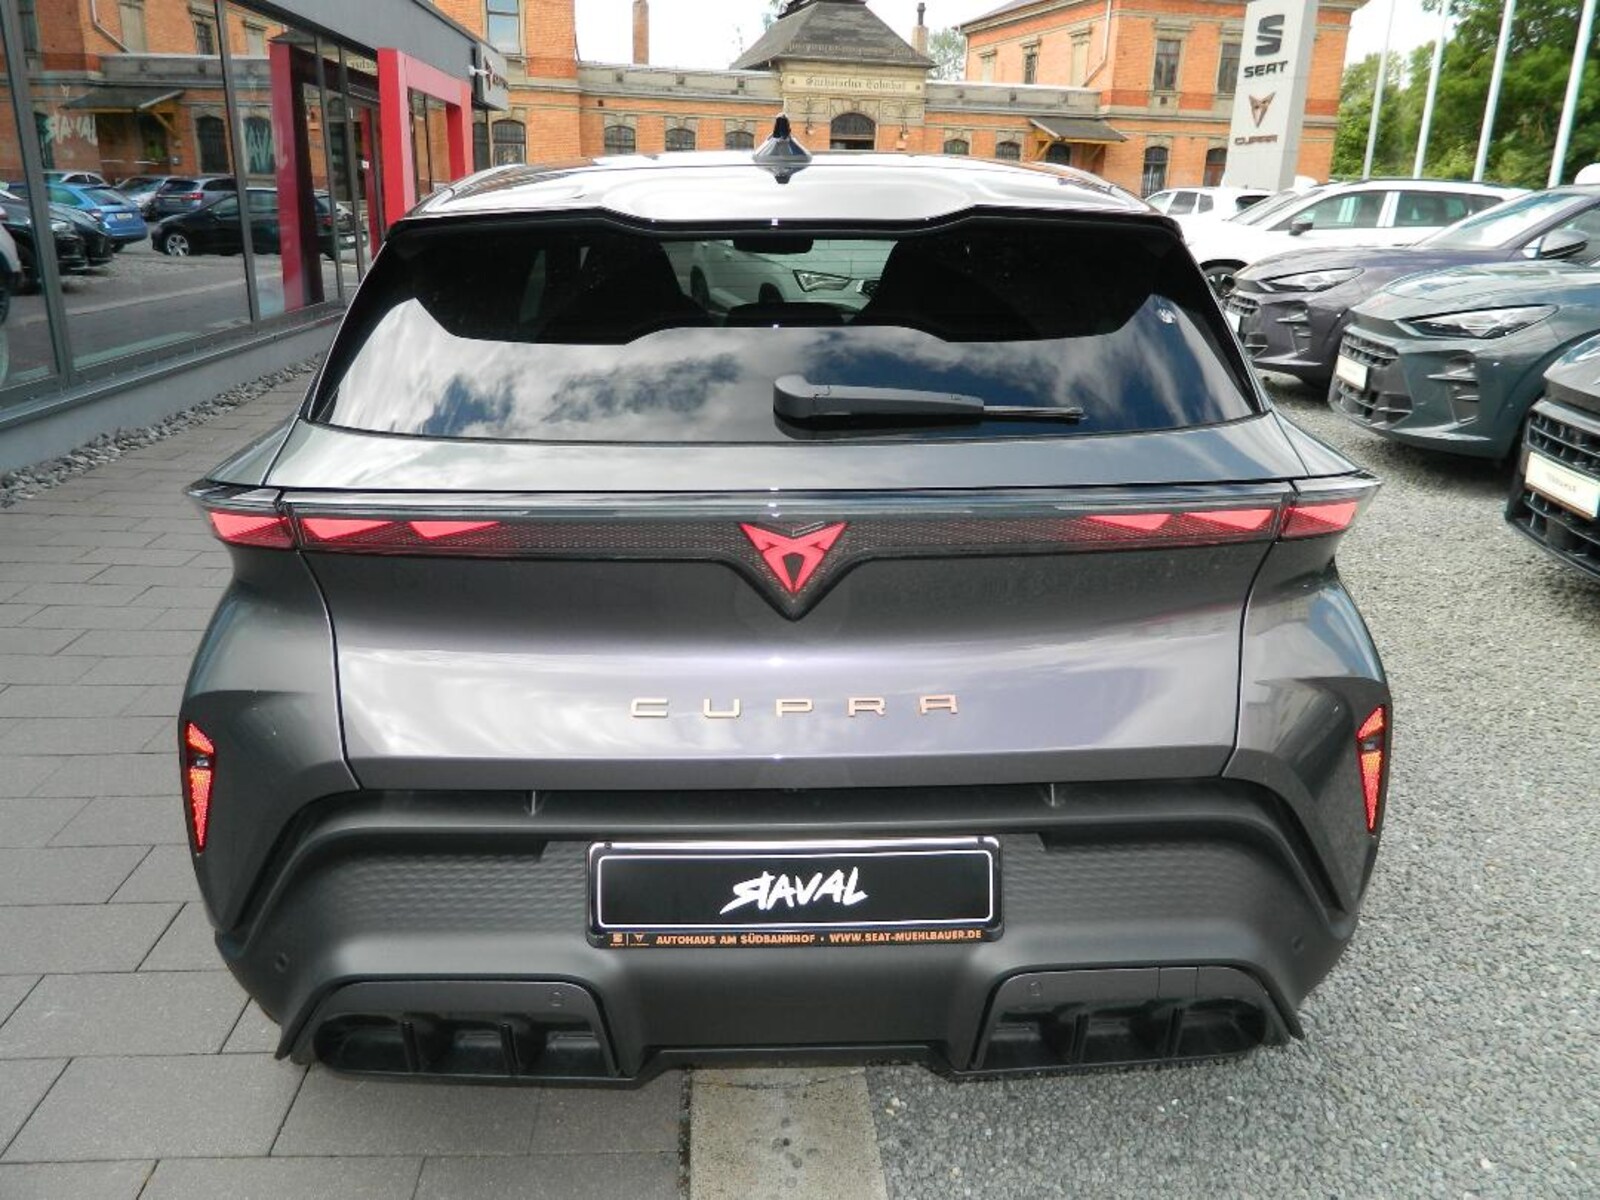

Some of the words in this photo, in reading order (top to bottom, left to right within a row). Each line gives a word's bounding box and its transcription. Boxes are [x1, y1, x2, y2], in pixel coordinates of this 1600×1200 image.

[1243, 60, 1288, 78] SEAT
[631, 694, 959, 718] CUPRA
[655, 935, 717, 945] AUTOHAUS
[719, 934, 738, 945] AM
[740, 932, 816, 944] SÜDBAHNHOF
[829, 929, 982, 943] WWW.SEAT-MUEHLBAUER.DE
